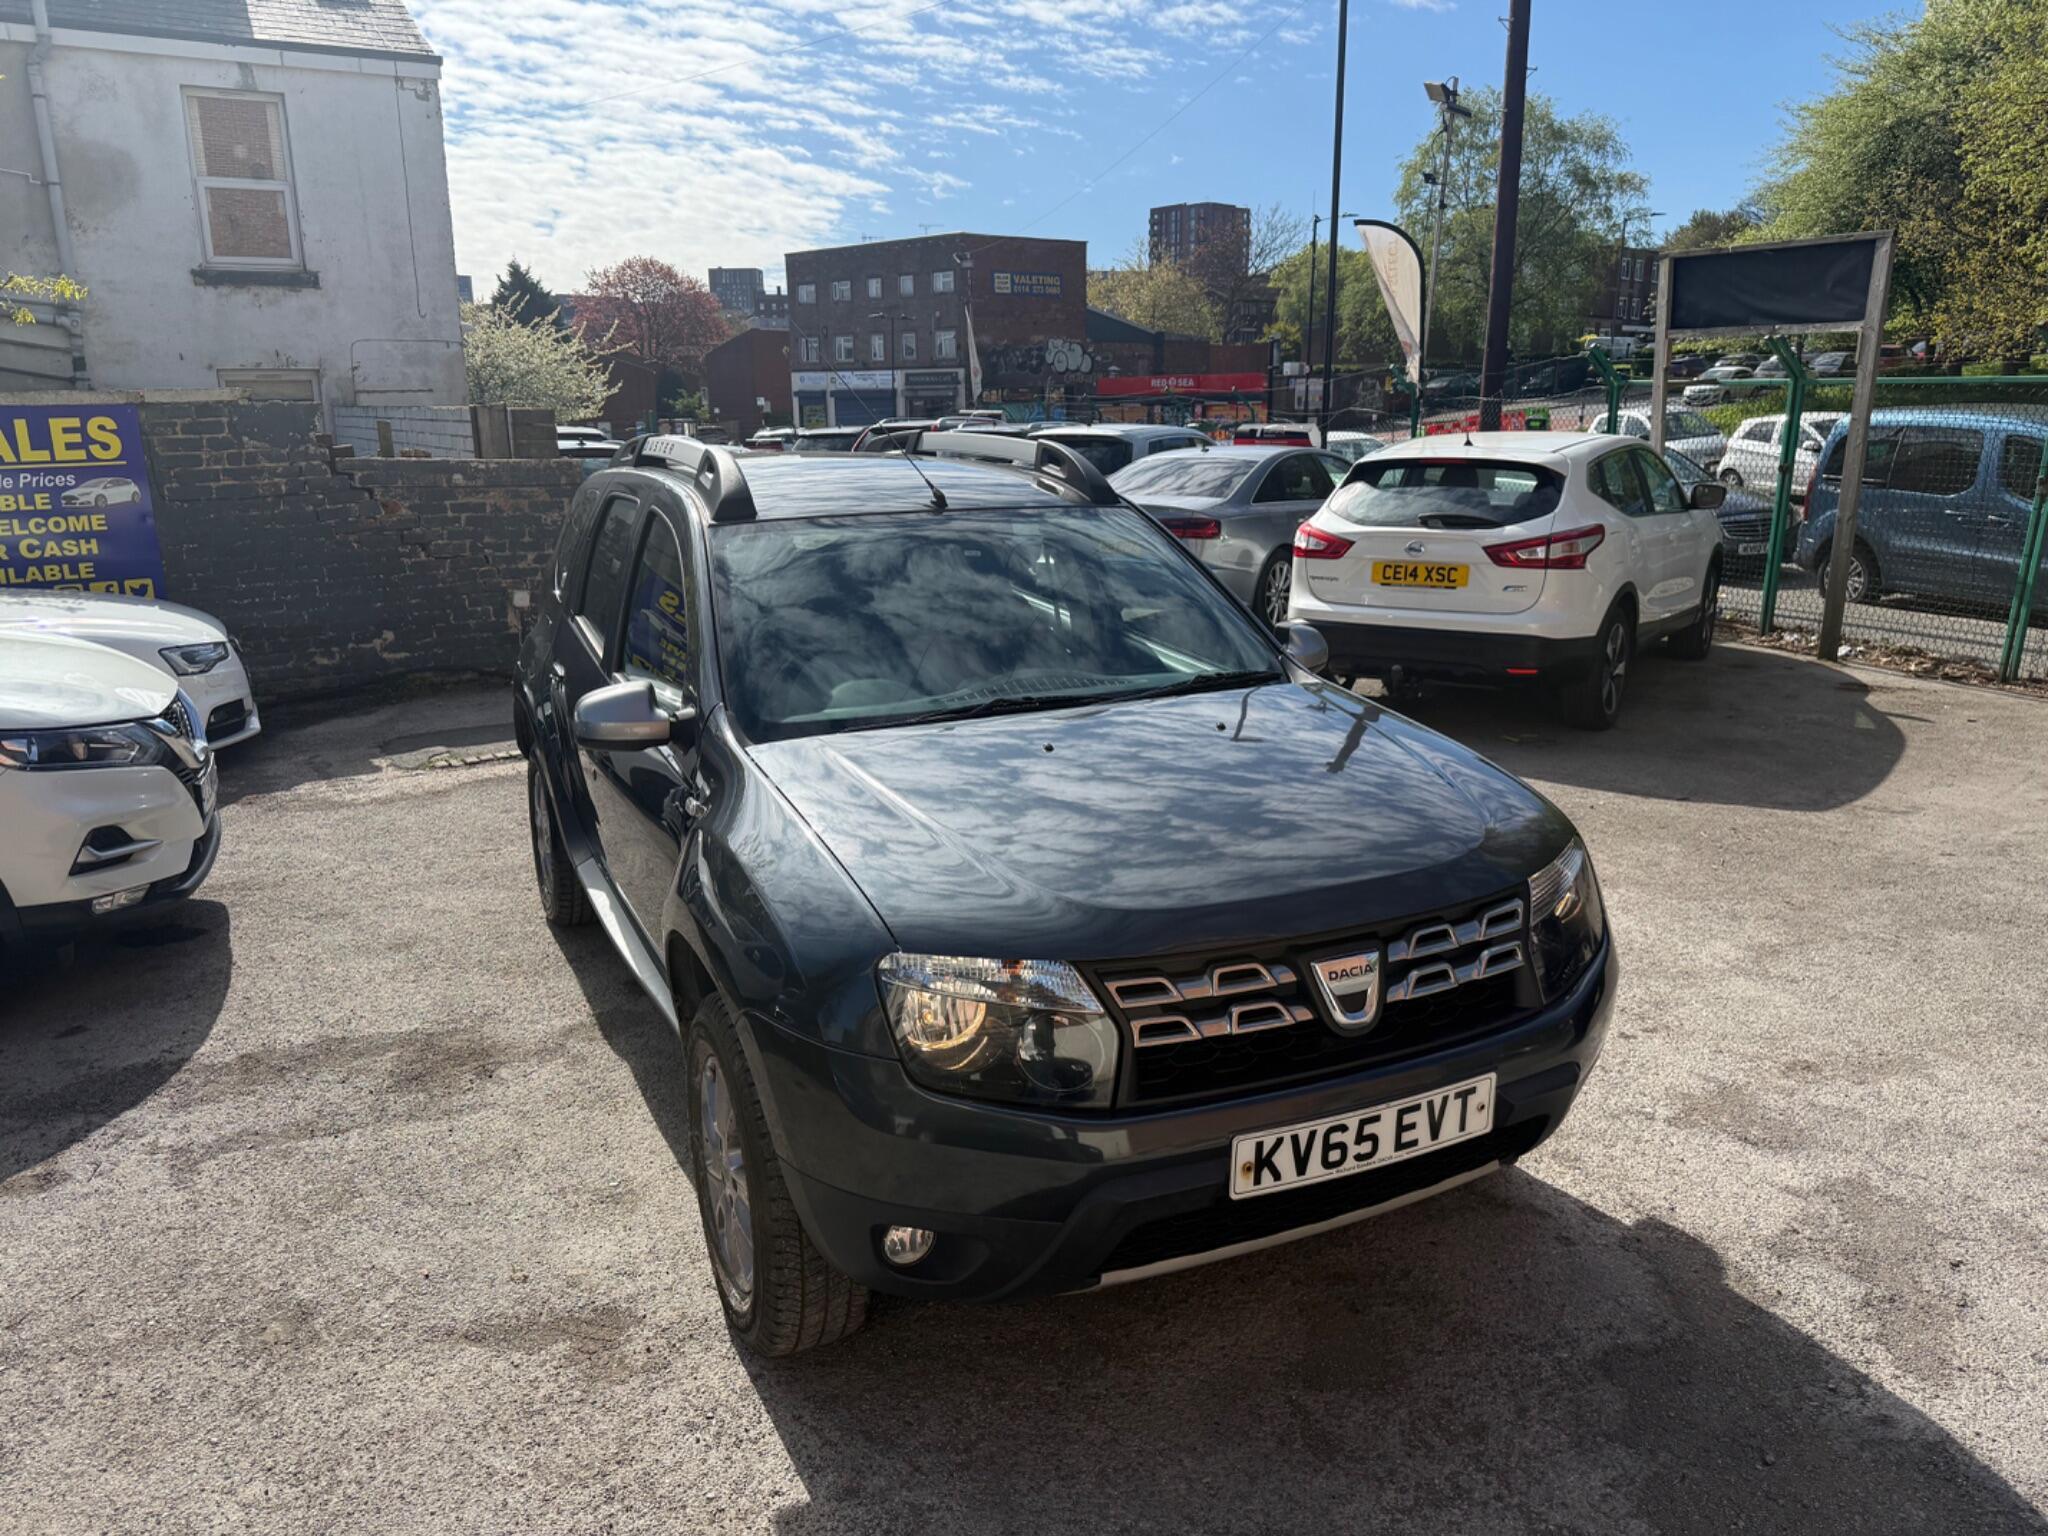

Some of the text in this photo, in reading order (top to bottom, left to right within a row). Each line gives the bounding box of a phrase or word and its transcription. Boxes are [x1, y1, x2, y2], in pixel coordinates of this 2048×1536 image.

[1013, 274, 1061, 285] VALETING
[1151, 377, 1194, 387] RED SEA
[19, 472, 76, 488] Prices
[0, 493, 52, 512] BLE
[0, 514, 108, 536] ELCOME
[19, 538, 99, 559] CASH
[1382, 564, 1458, 583] CE14 XSC
[1328, 964, 1373, 981] DACIA
[1253, 1086, 1477, 1187] KV65 EVT
